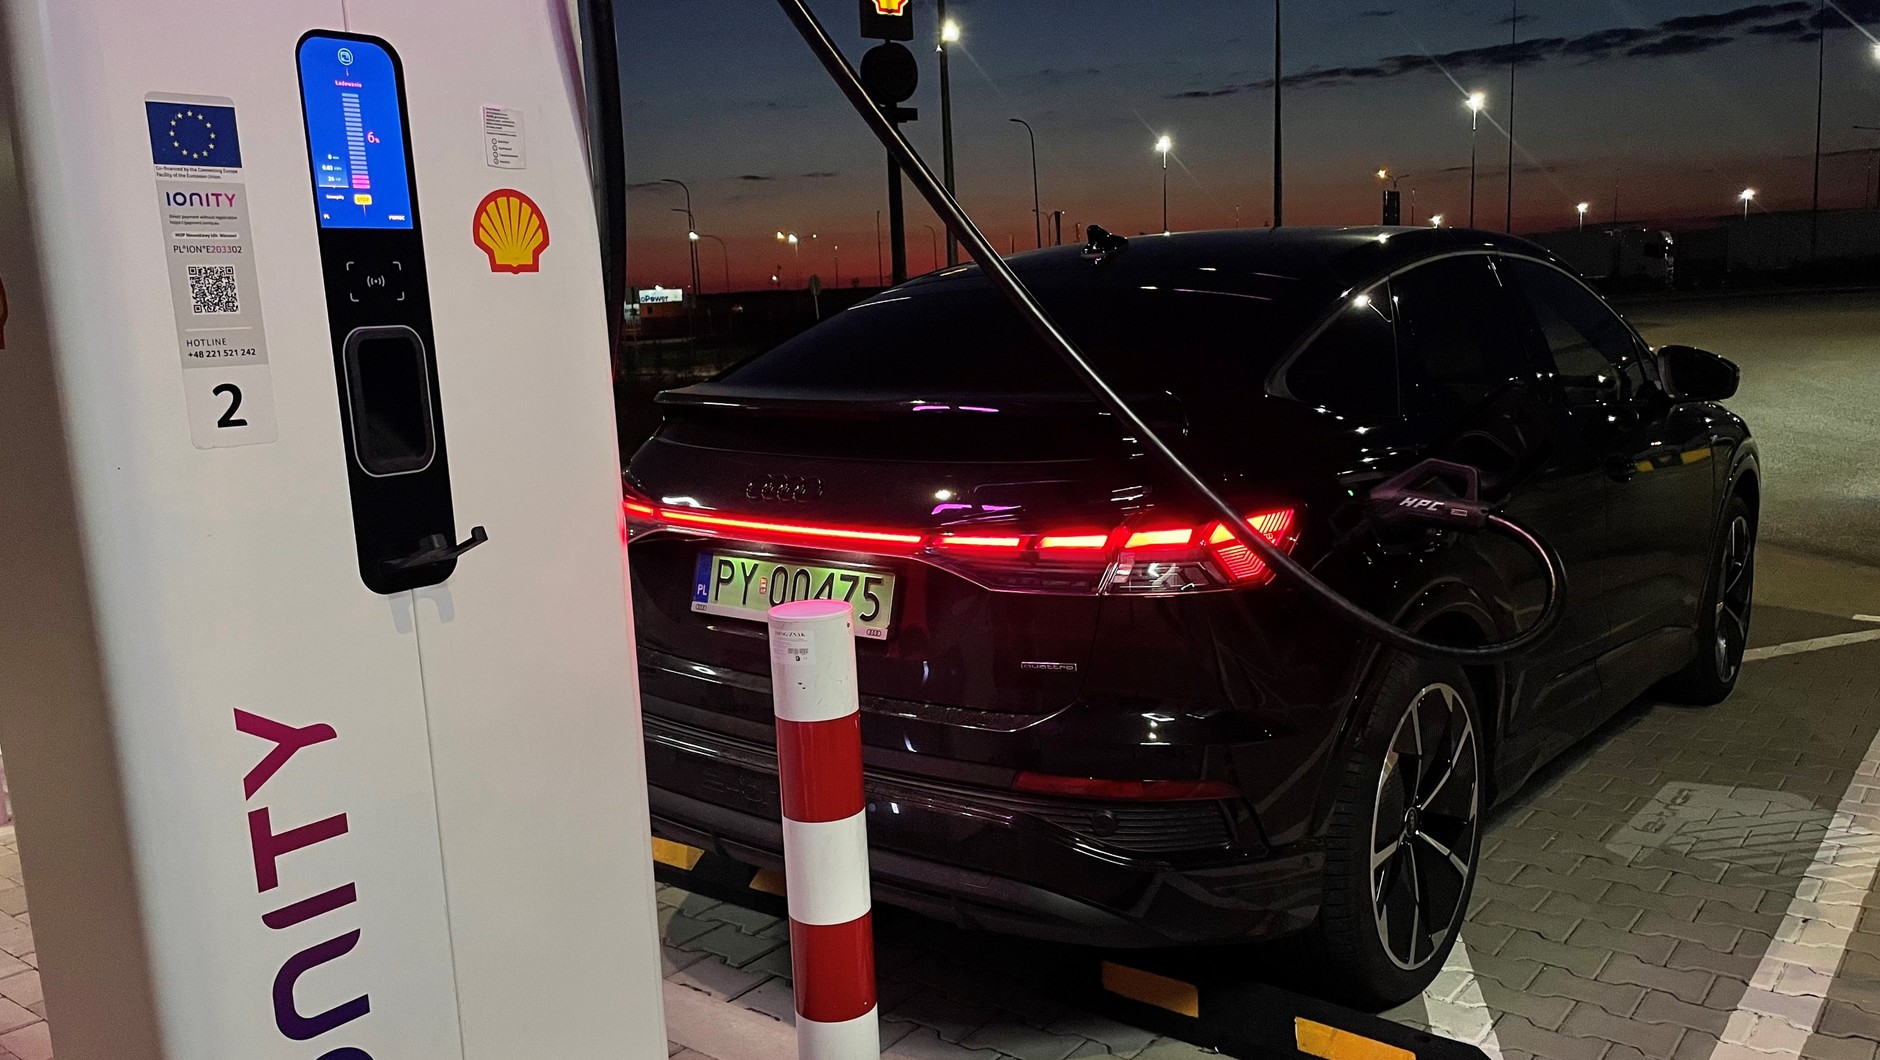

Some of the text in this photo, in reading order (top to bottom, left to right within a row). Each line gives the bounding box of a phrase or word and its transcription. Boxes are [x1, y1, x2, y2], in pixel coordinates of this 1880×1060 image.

[166, 191, 236, 208] IONITY
[186, 338, 228, 347] HOTLINE
[187, 348, 256, 358] +48 221 521 242
[212, 383, 248, 428] 2
[1399, 496, 1445, 511] HPC
[714, 558, 760, 605] PY
[697, 583, 708, 596] PL
